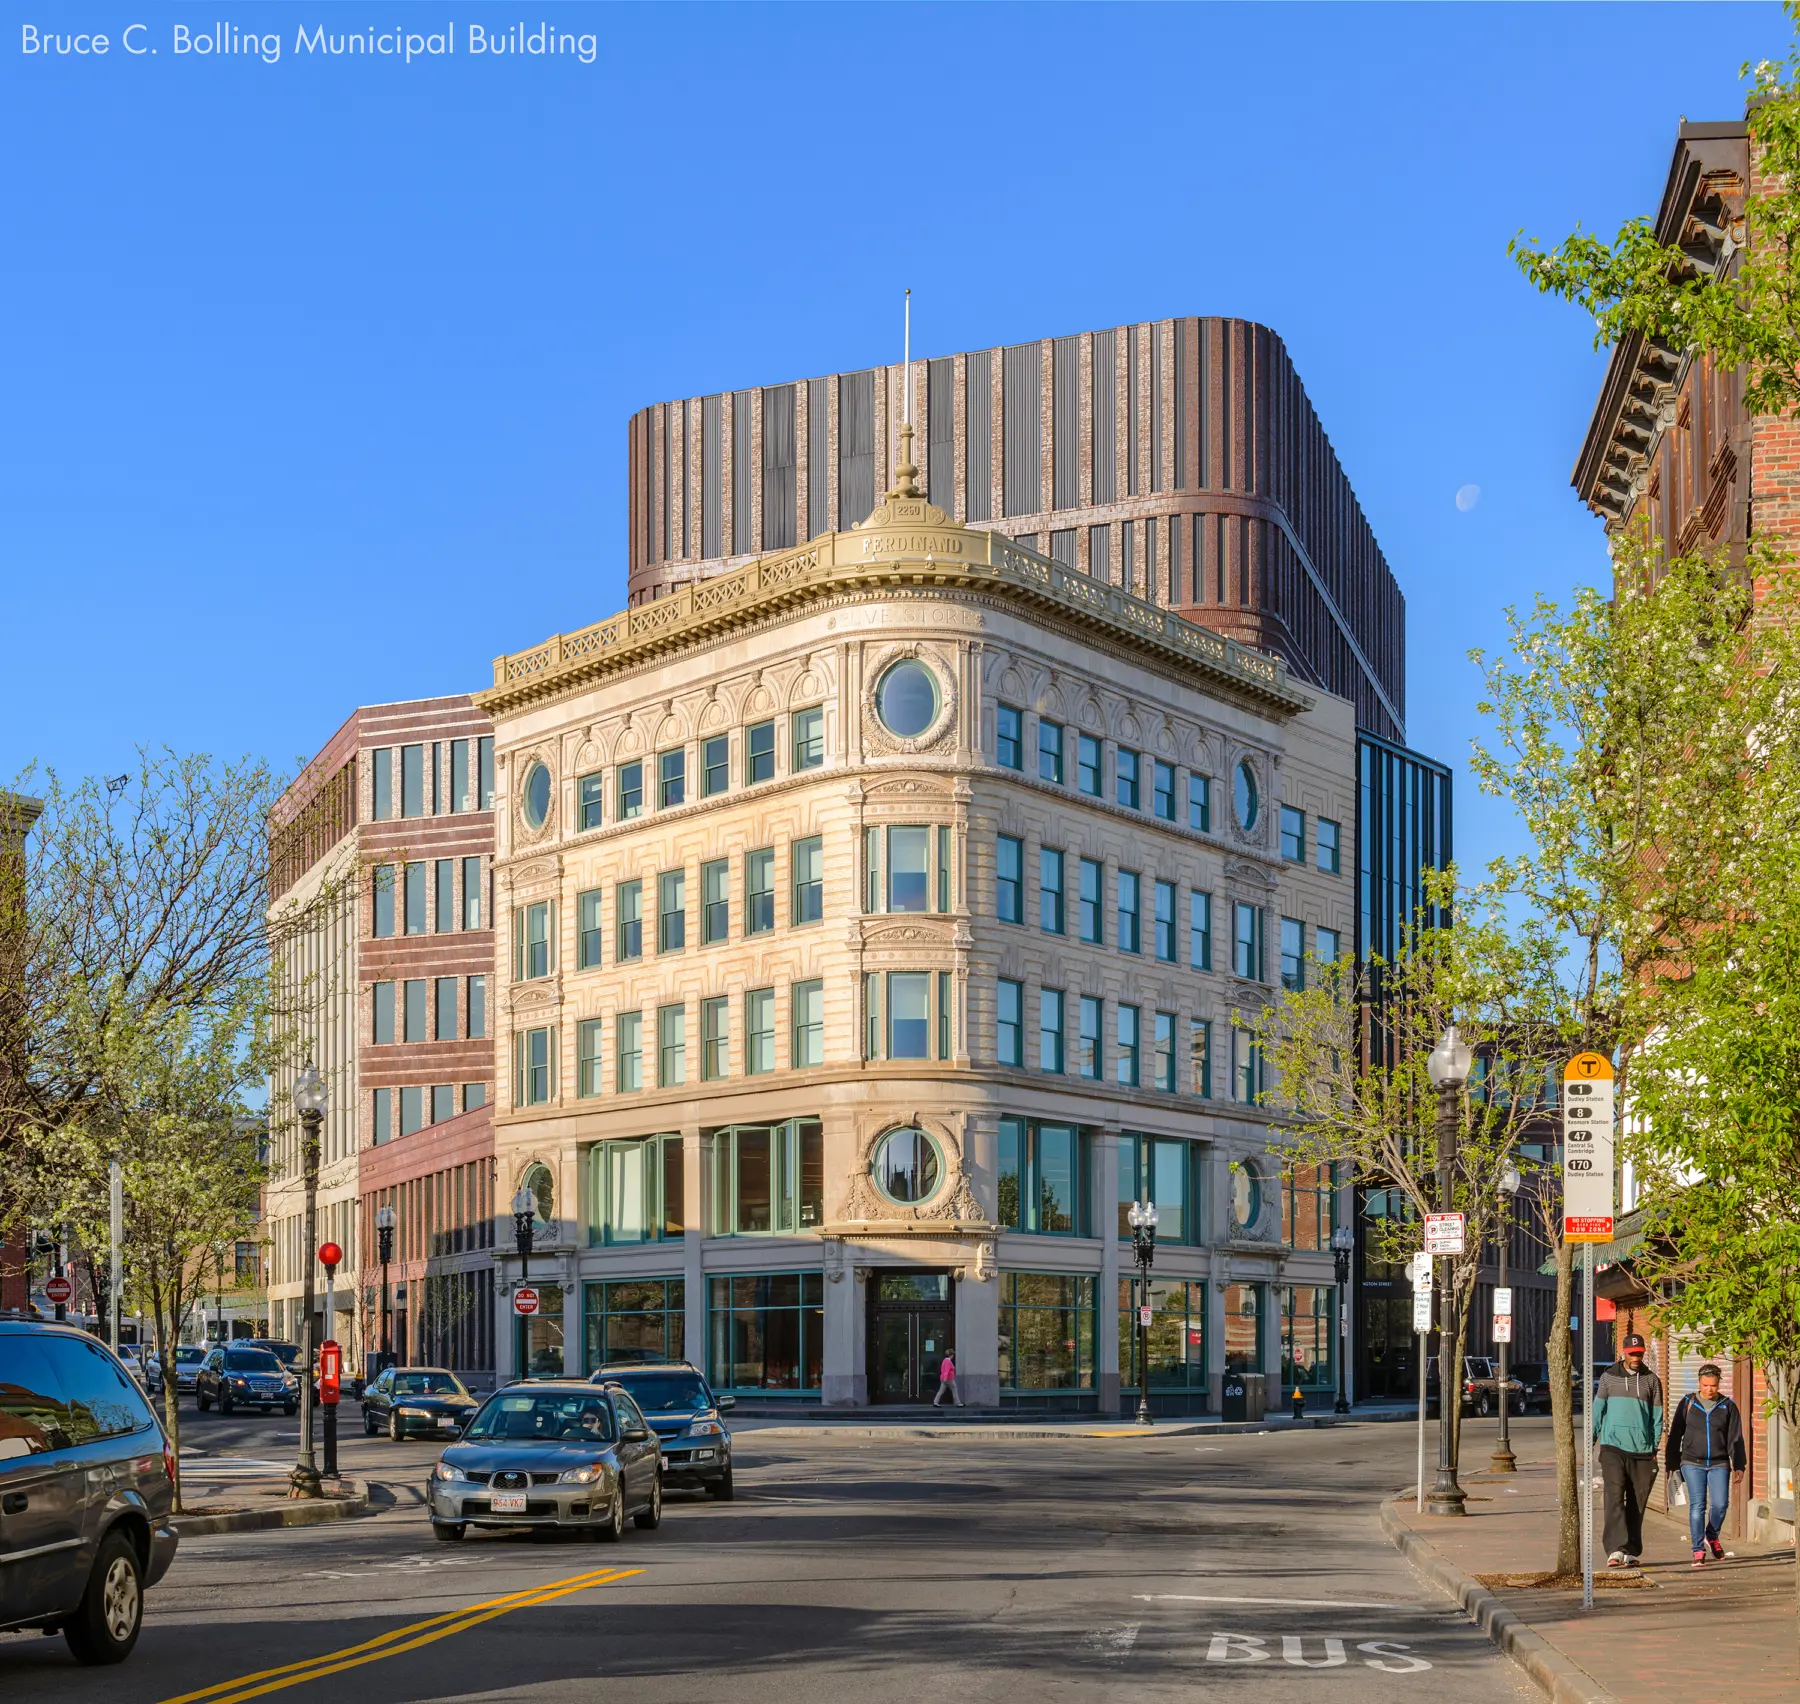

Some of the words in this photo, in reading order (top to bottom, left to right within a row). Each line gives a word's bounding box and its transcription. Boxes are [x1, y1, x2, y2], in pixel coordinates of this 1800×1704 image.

[862, 536, 963, 554] FERDINAND
[904, 608, 974, 626] STORE
[1581, 1060, 1597, 1074] T
[1577, 1085, 1583, 1095] 1
[1577, 1108, 1584, 1118] 8
[1573, 1131, 1587, 1141] 47
[1570, 1160, 1590, 1170] 170
[1632, 1337, 1638, 1345] B
[1205, 1631, 1394, 1673] BUS
